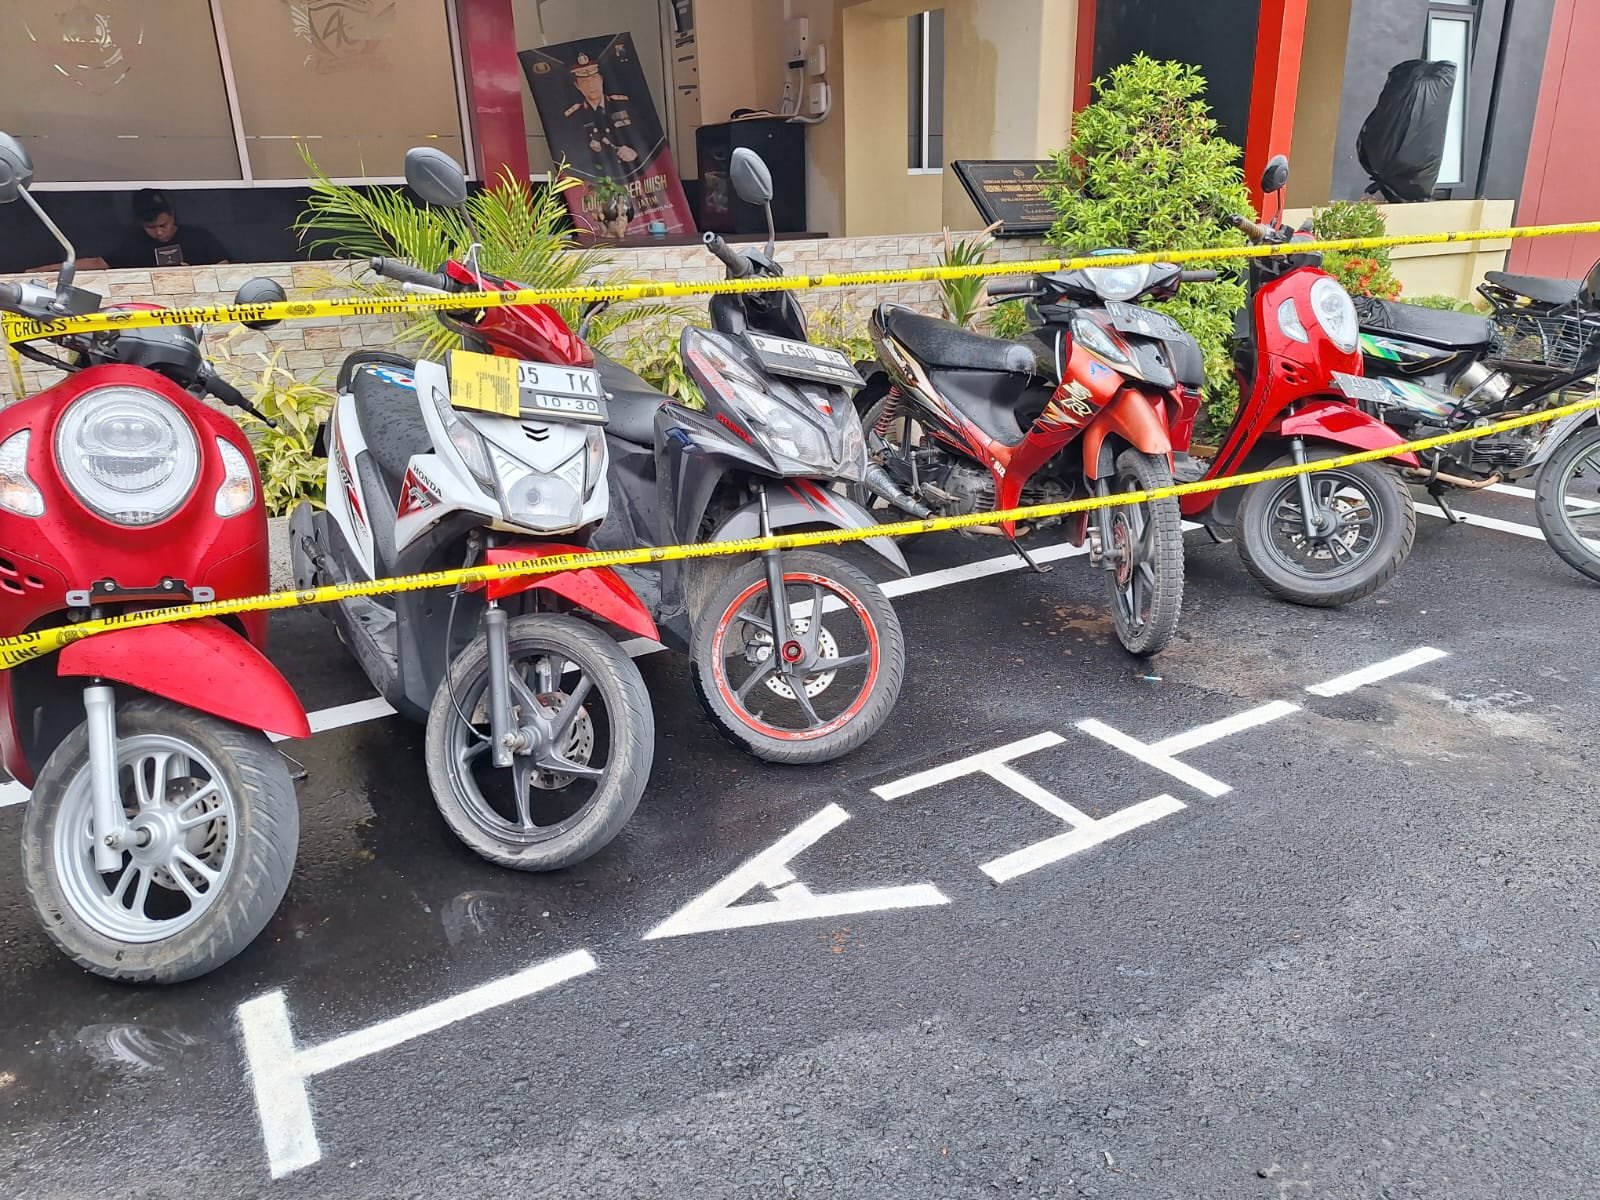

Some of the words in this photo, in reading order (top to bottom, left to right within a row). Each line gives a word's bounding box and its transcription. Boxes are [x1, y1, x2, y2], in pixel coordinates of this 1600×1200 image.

[643, 174, 668, 194] WISH
[14, 320, 68, 338] CROSS
[566, 373, 593, 393] TK
[413, 463, 443, 498] HONDA
[497, 555, 568, 572] DILARANG
[3, 646, 42, 665] LINE
